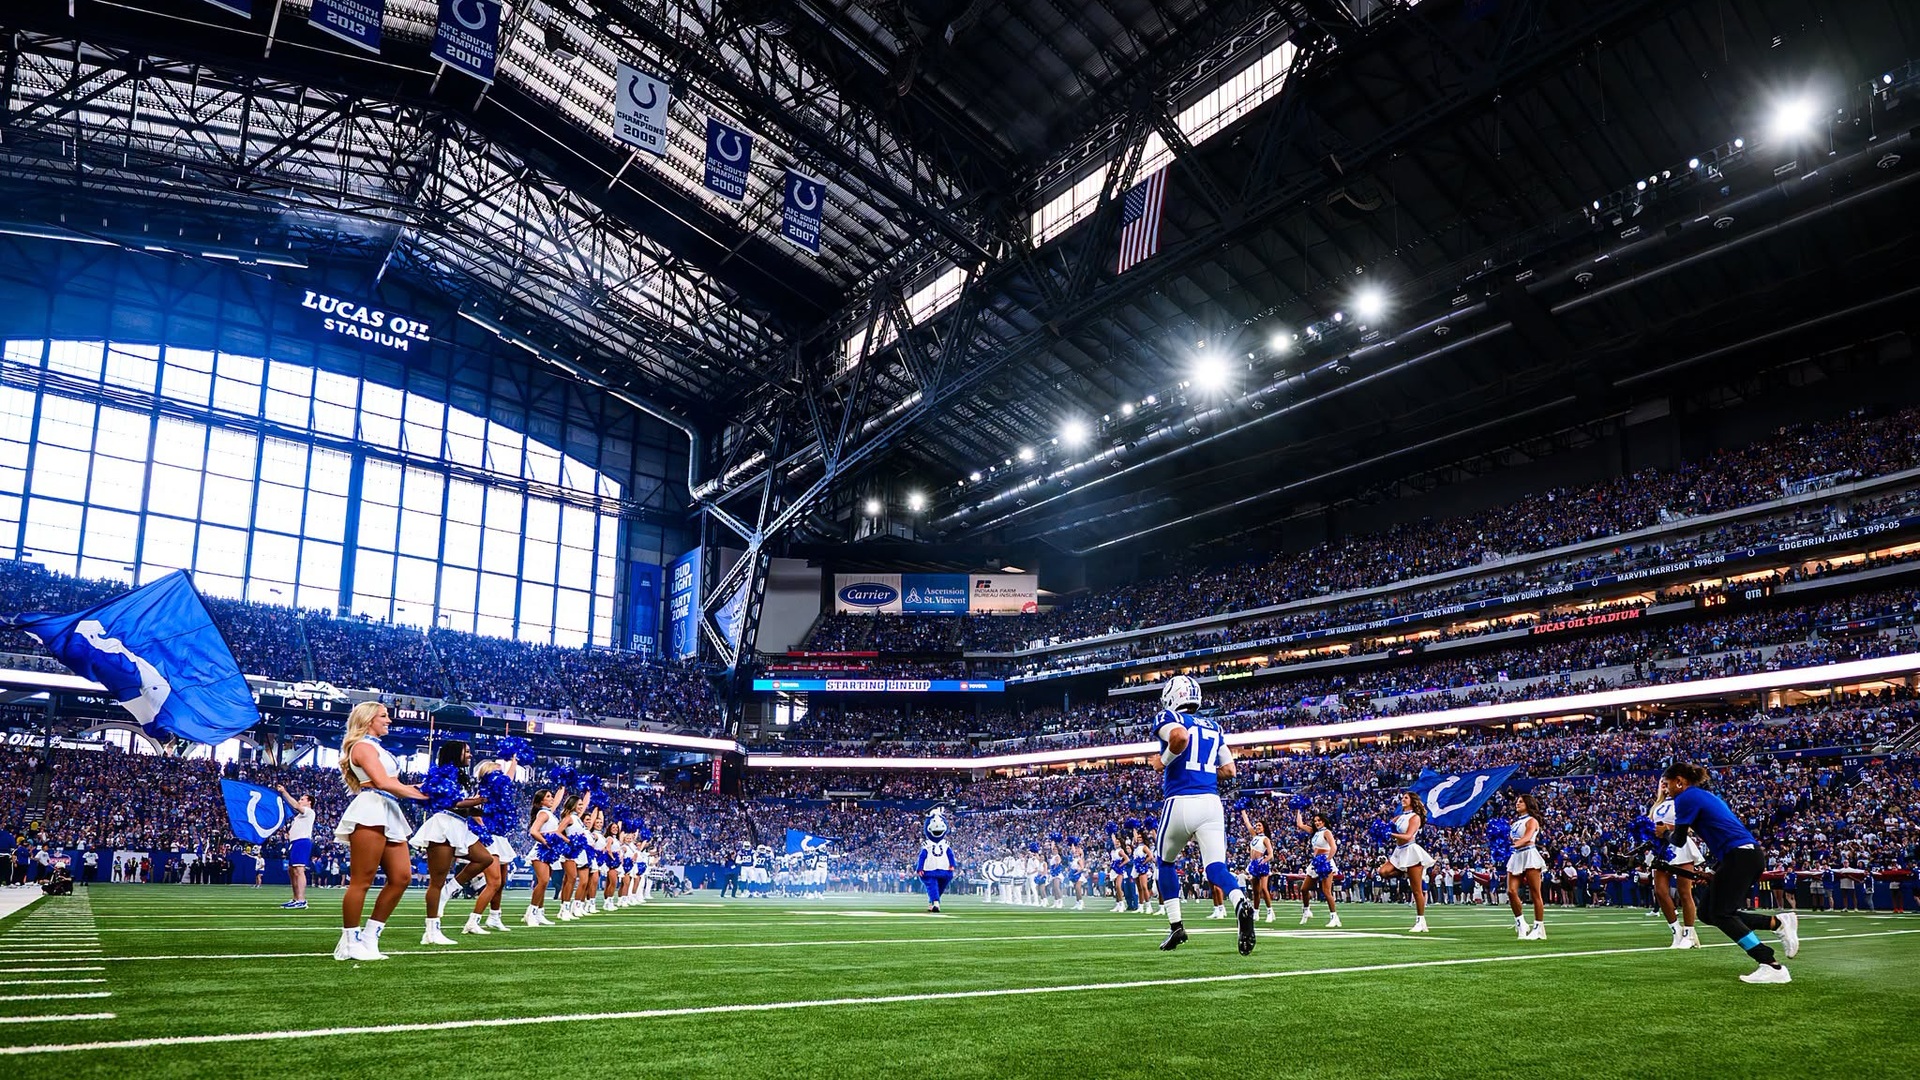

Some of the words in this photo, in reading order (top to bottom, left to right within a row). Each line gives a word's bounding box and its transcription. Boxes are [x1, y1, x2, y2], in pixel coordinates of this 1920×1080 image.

[318, 0, 379, 27] HAMPIONS
[327, 10, 366, 36] 2013
[437, 28, 494, 59] CHAMPIONS
[440, 22, 459, 35] AFC
[460, 31, 492, 51] SOUTH
[446, 44, 482, 69] 2010
[617, 111, 664, 136] CHAMPIONS
[633, 111, 650, 122] AFC
[623, 123, 656, 145] 2009
[708, 156, 722, 168] AFC
[706, 163, 746, 185] CHAMPION
[712, 175, 742, 196] 2009
[786, 206, 799, 217] AFC
[789, 224, 815, 244] 2007
[301, 290, 385, 327] LUCAS
[389, 317, 430, 342] OIL
[323, 318, 409, 352] STADIUM
[1778, 535, 1825, 551] EDGERRIN
[1826, 529, 1859, 543] JAMES
[1863, 520, 1900, 535] 1999-05
[674, 562, 691, 580] BUD
[1617, 570, 1648, 582] MARVIN
[1649, 562, 1690, 576] HARRISON
[1693, 555, 1726, 568] 1996-08
[671, 573, 693, 594] LIGHT
[924, 587, 965, 595] Ascension
[670, 591, 692, 610] PARTY
[847, 589, 891, 600] Carrier
[1502, 594, 1520, 604] TONY
[1521, 590, 1544, 600] DUNGY
[1547, 584, 1574, 595] 2002-08
[1745, 588, 1762, 600] QTR
[671, 604, 689, 622] ZONE
[1423, 610, 1441, 619] COLTS
[1442, 605, 1465, 615] NATION
[1533, 622, 1565, 635] LUCAS
[1567, 618, 1585, 629] OIL
[1587, 609, 1640, 626] STADIUM
[632, 634, 653, 645] BUD
[827, 681, 884, 690] STARTING
[887, 681, 930, 690] LINEUP
[398, 709, 418, 719] QTR
[420, 711, 425, 720] 1
[1155, 711, 1167, 726] 17
[1185, 725, 1220, 774] 17
[1843, 758, 1858, 766] 115
